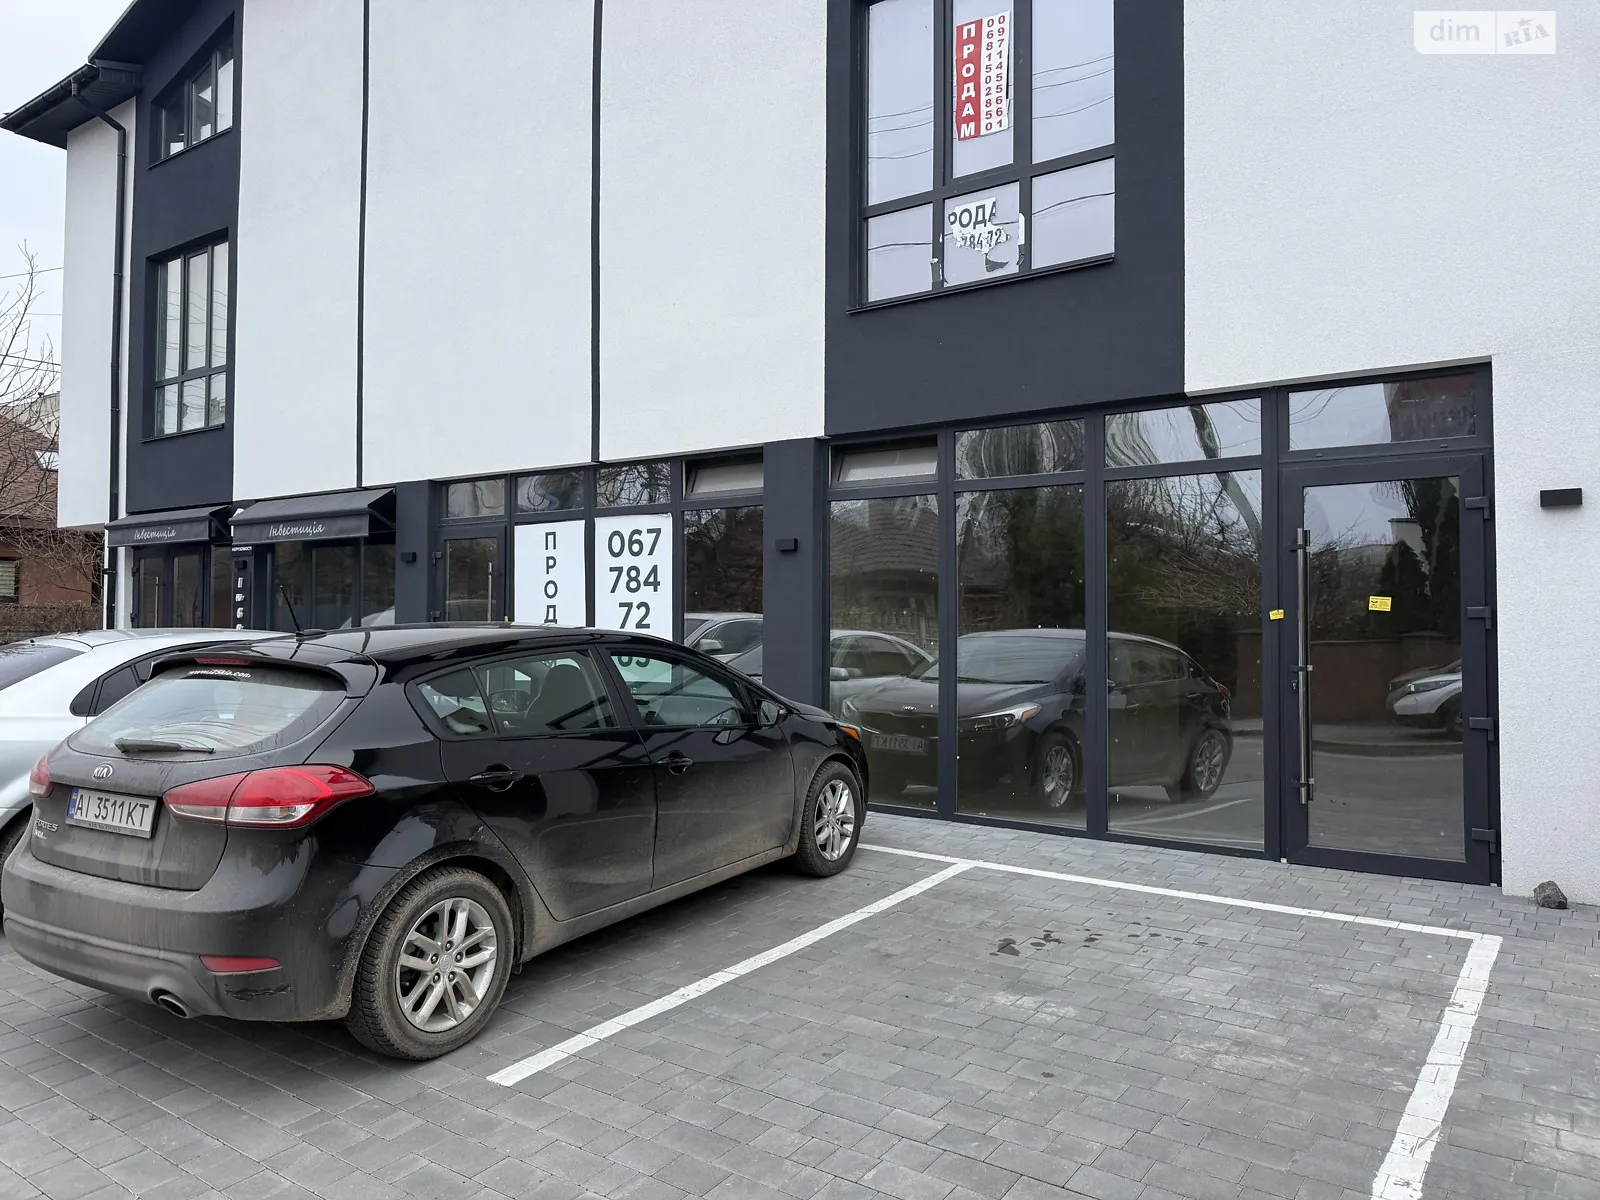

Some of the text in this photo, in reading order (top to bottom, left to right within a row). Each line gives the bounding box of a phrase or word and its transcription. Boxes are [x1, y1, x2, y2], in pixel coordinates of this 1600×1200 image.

[960, 23, 976, 139] ПРОДАМ
[607, 527, 662, 558] 067
[608, 564, 661, 594] 784
[618, 601, 651, 629] 72
[74, 794, 91, 818] AI
